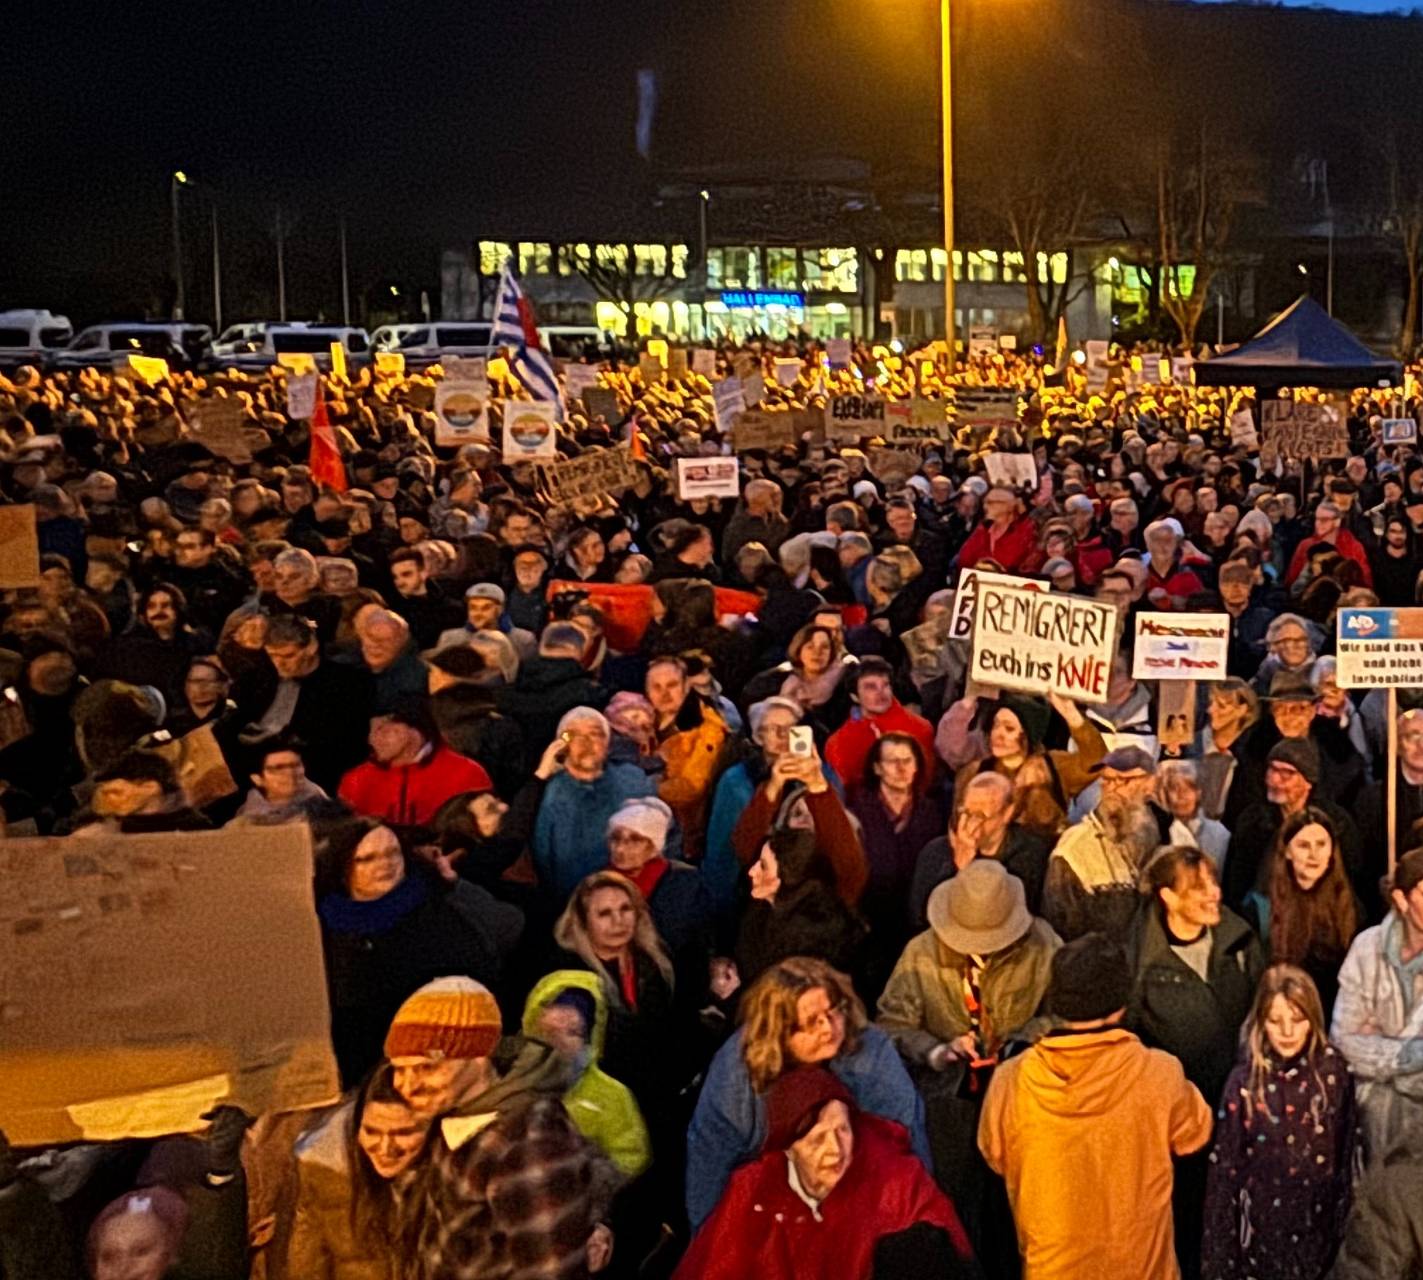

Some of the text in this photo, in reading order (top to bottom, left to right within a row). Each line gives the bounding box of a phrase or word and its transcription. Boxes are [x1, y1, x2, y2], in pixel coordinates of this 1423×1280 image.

[721, 291, 803, 306] HALLENBAD
[982, 590, 1115, 648] REMIGRIERT
[1339, 642, 1361, 652] Wir
[1364, 642, 1390, 652] sind
[1394, 642, 1416, 652] das
[1363, 658, 1422, 668] und nicht
[979, 648, 1108, 696] euch ins KNIE
